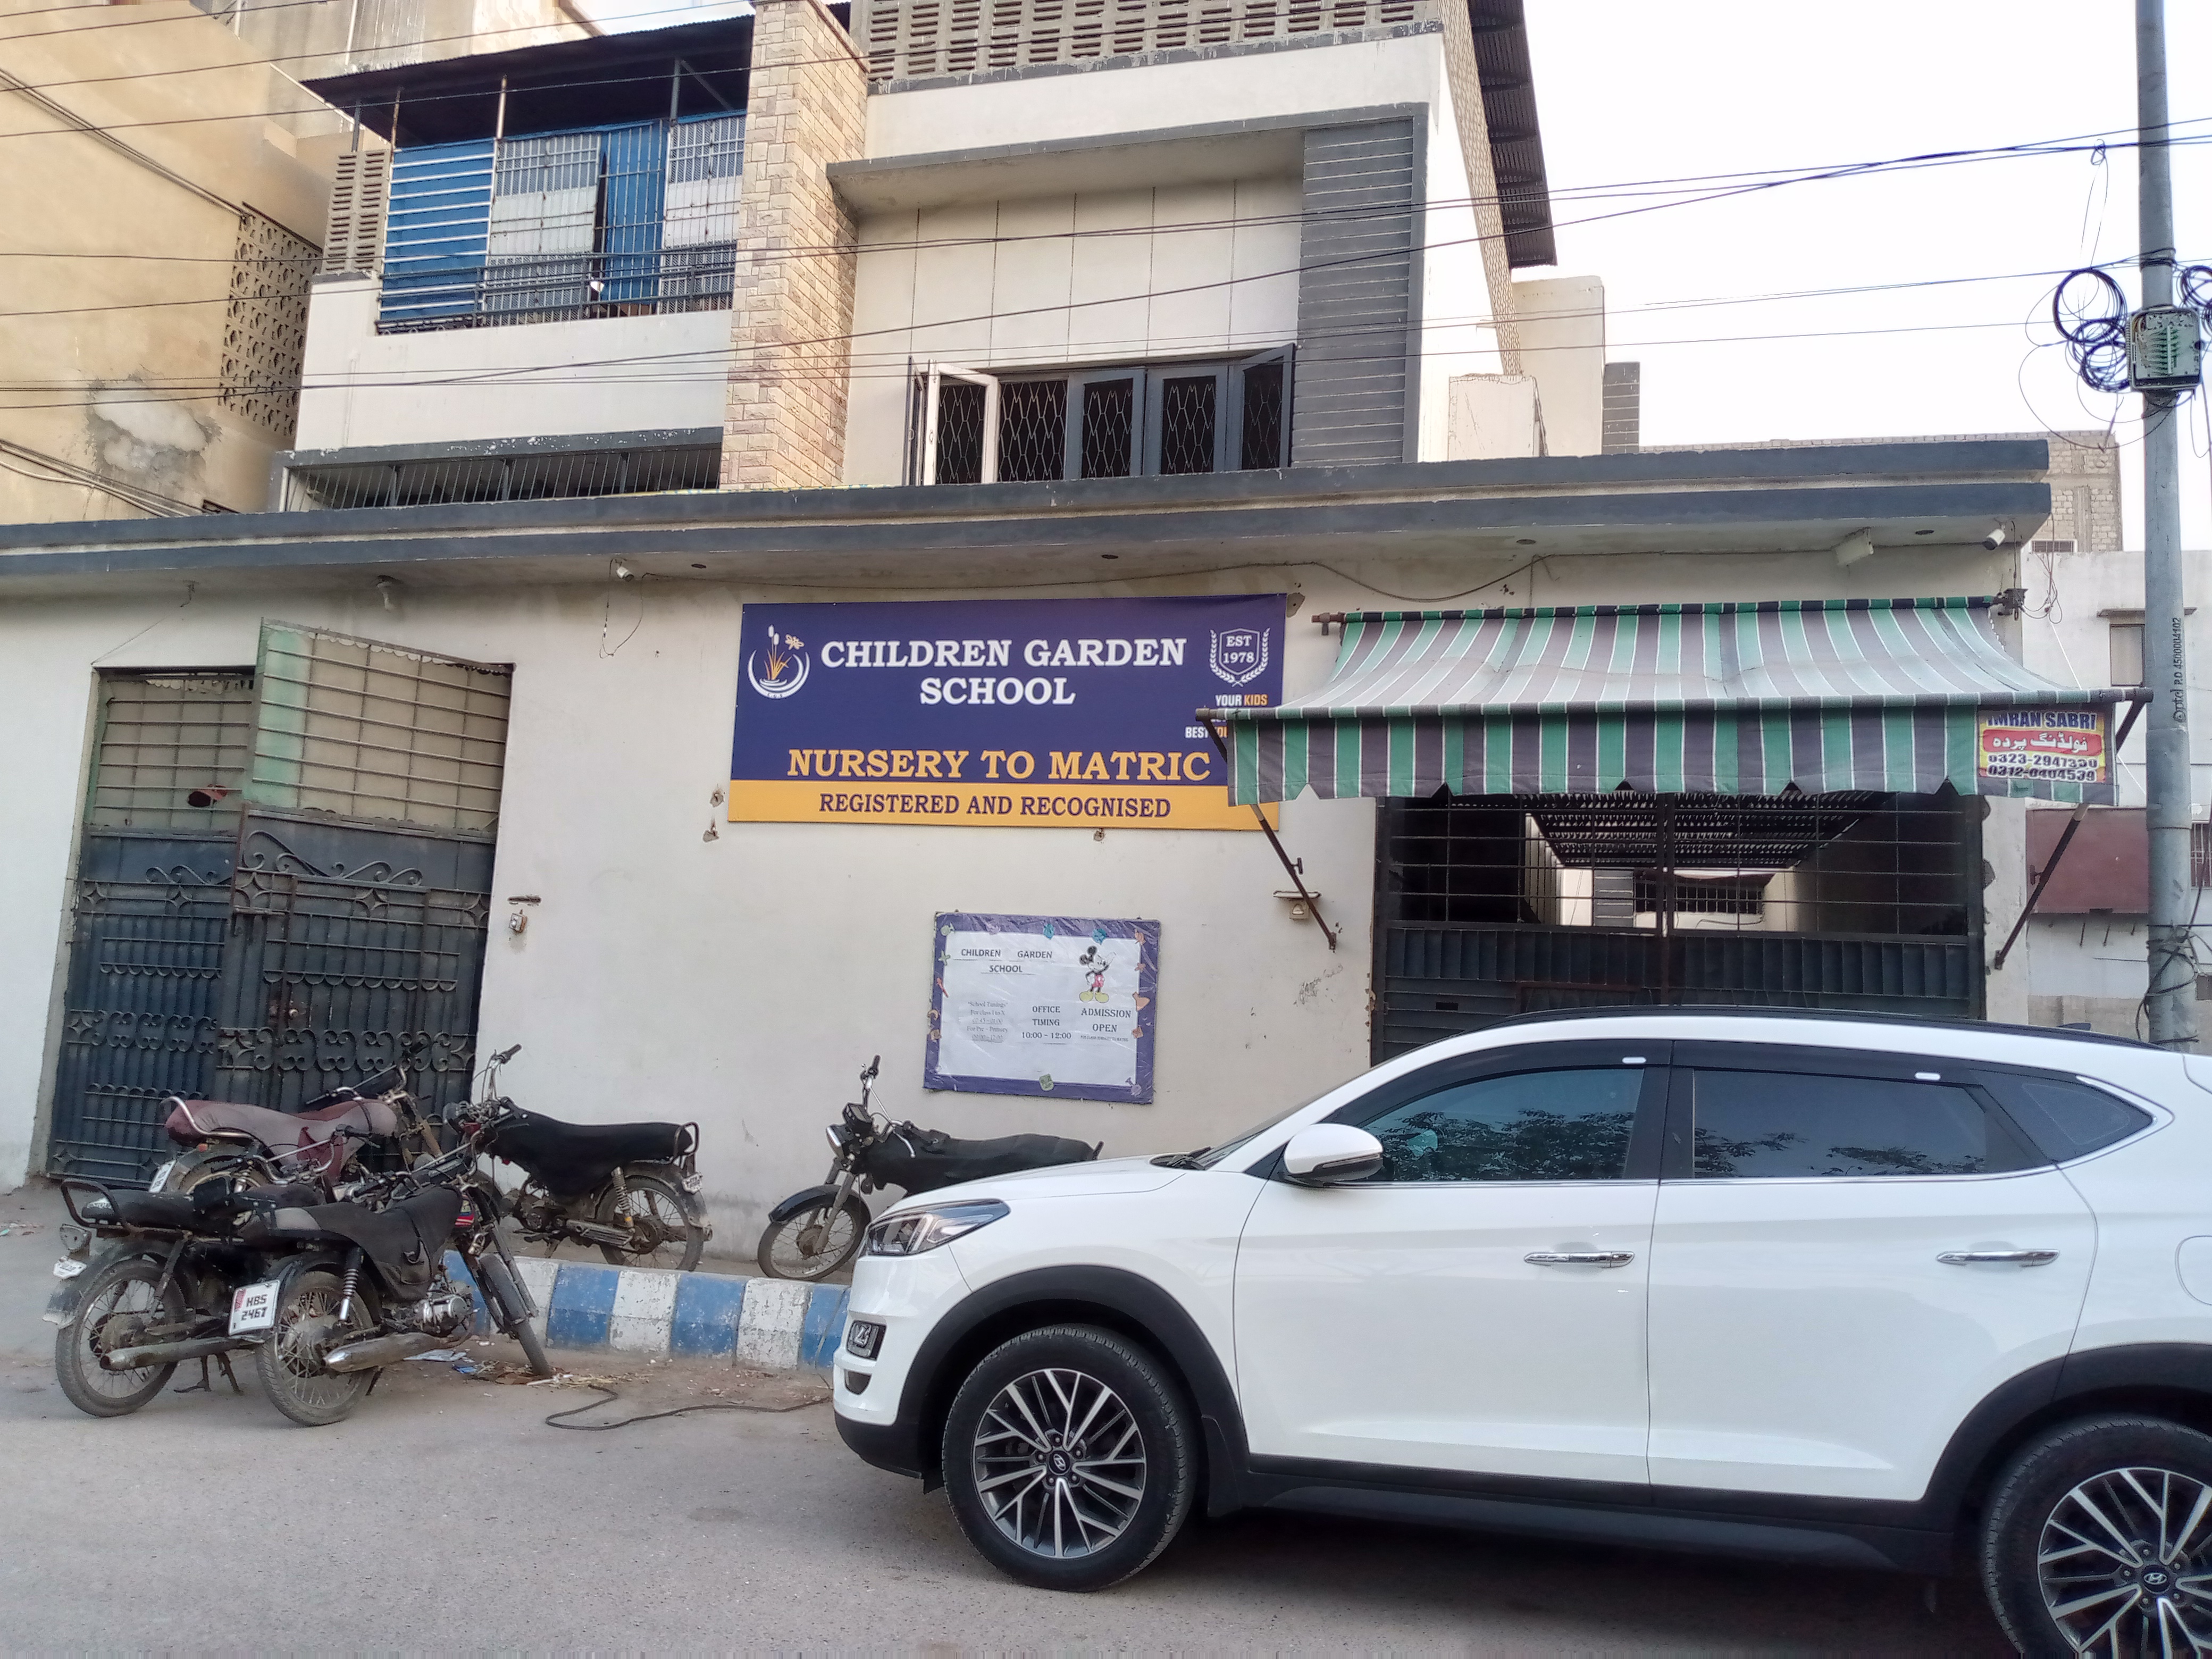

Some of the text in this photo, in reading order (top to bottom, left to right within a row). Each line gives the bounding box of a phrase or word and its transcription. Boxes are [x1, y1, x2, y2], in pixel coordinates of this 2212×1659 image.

[1226, 635, 1252, 647] EST
[820, 638, 1187, 668] CHILDREN GARDEN
[1223, 651, 1255, 664] 1978
[919, 677, 1077, 705] SCHOOL
[1215, 694, 1269, 706] YOUR KIDS
[1987, 712, 2097, 730] IMRAN SABRI
[1185, 726, 1209, 739] BEST
[787, 749, 1211, 781] NURSERY TO MATRIC
[819, 793, 1171, 818] REGISTERED AND RECOGNISED
[961, 949, 1053, 959] CHILDREN GARDEN
[1081, 1008, 1131, 1018] ADMISSION
[1092, 1023, 1117, 1033] OPEN
